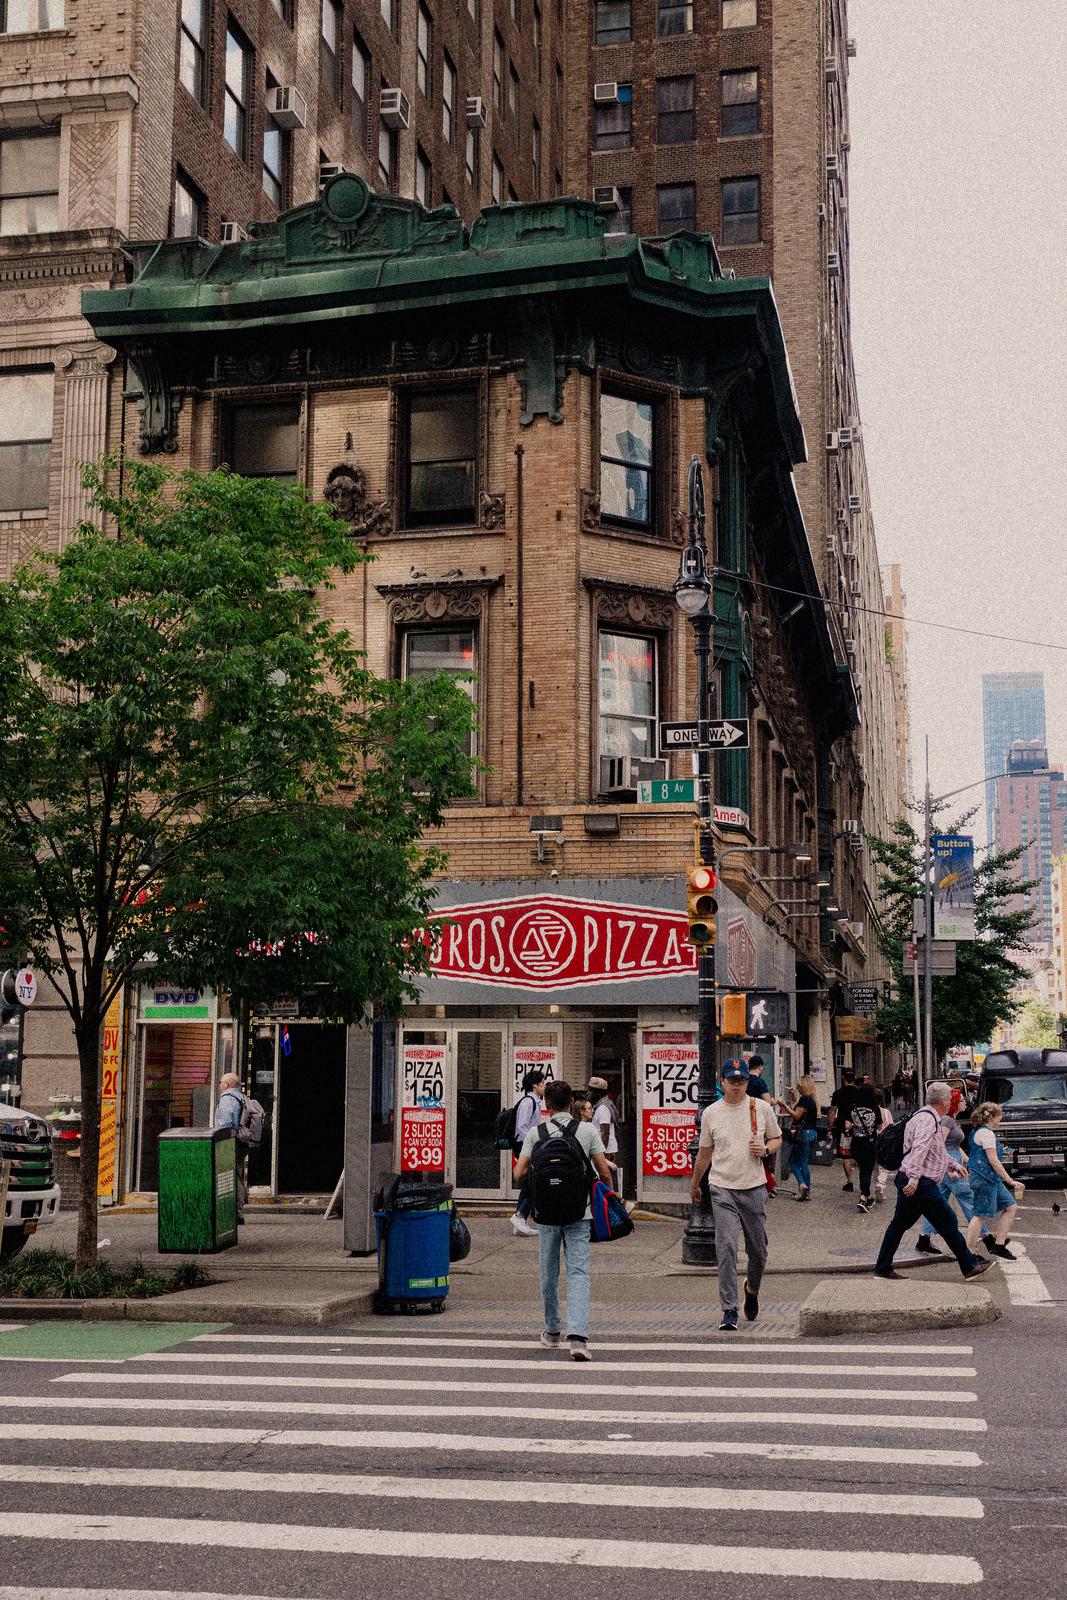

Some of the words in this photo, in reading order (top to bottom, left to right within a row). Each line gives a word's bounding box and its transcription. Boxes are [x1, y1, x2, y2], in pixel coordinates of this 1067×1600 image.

[673, 730, 698, 741] ONE
[709, 728, 735, 740] WAY
[661, 783, 668, 799] 8
[674, 783, 684, 792] Av
[937, 840, 970, 848] Button
[937, 849, 953, 857] up!
[583, 915, 682, 973] PIZZA
[19, 985, 33, 998] NY
[154, 991, 198, 1005] DVD
[405, 1062, 443, 1078] PIZZA
[646, 1064, 699, 1080] PIZZA
[646, 1081, 700, 1107] $1.50
[404, 1124, 410, 1137] 2
[411, 1124, 442, 1138] SLICES
[646, 1128, 653, 1142] 2
[657, 1128, 698, 1142] SLICE
[408, 1138, 419, 1146] CAN
[420, 1138, 427, 1146] OF
[428, 1138, 442, 1147] SODA
[652, 1142, 668, 1150] CAN
[670, 1142, 680, 1150] OF
[403, 1147, 442, 1168] $3.99
